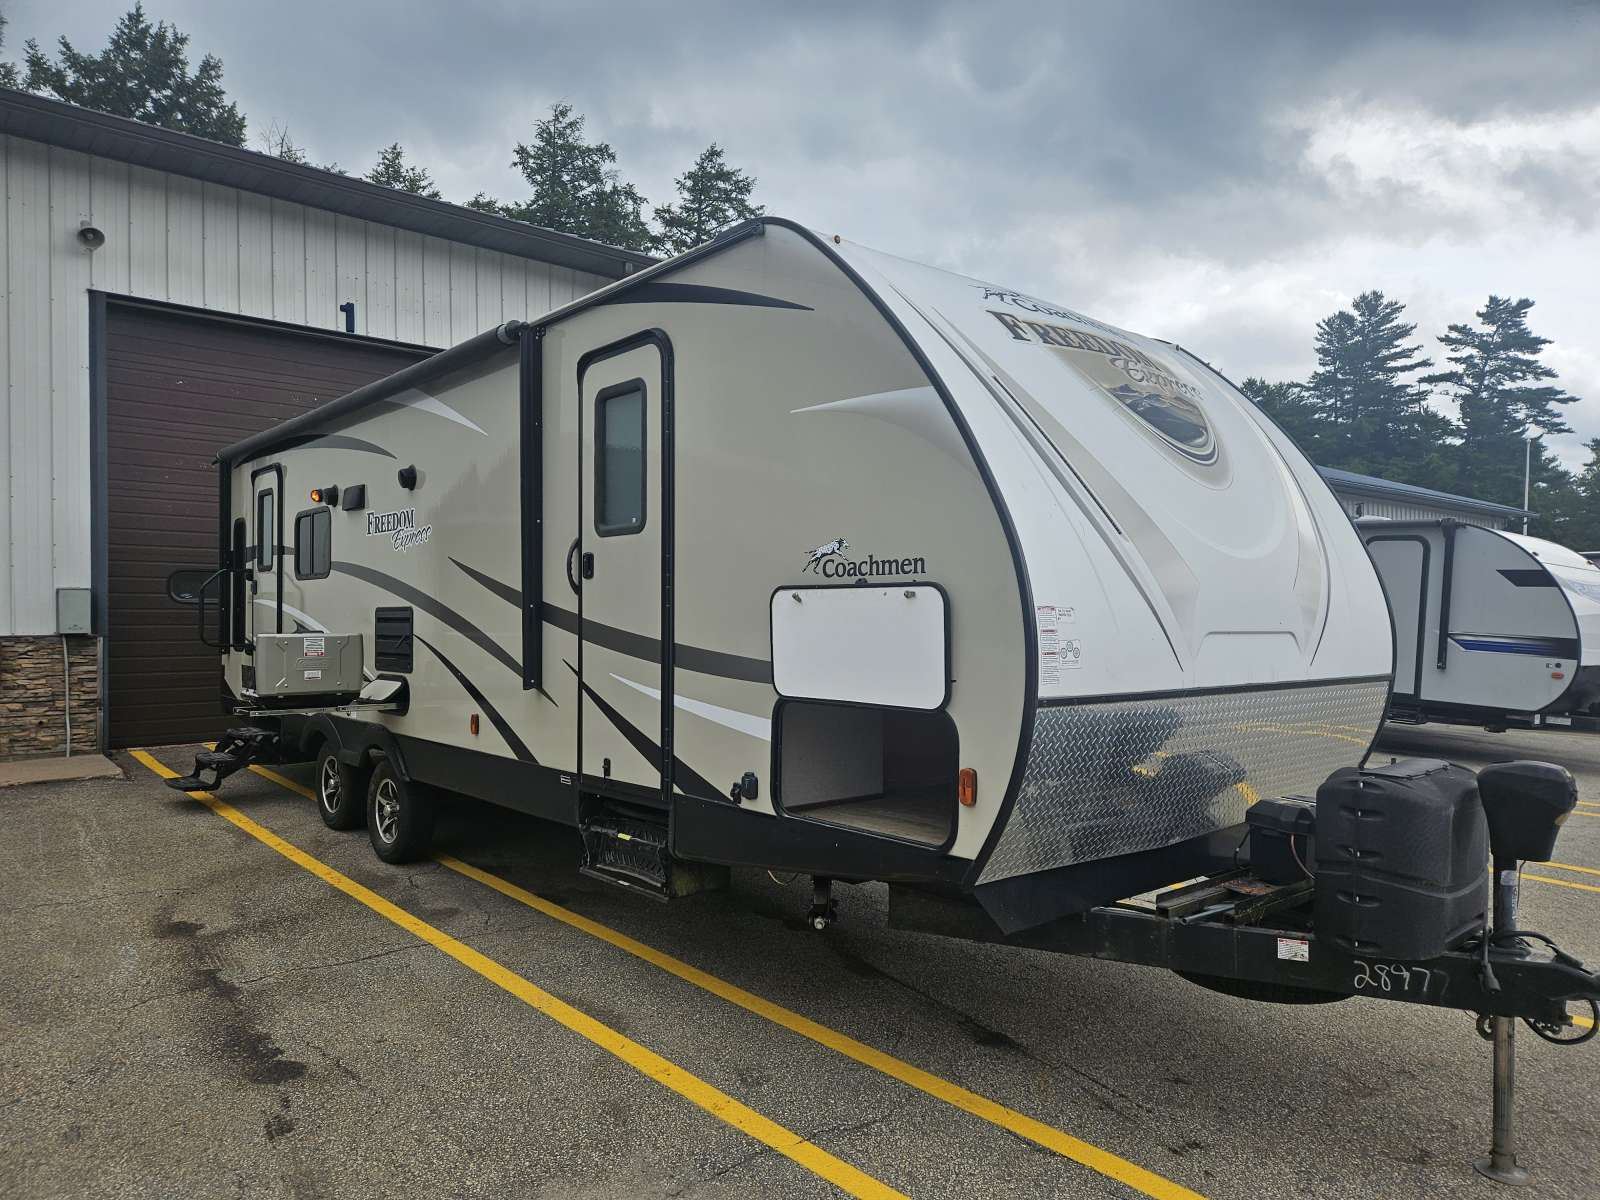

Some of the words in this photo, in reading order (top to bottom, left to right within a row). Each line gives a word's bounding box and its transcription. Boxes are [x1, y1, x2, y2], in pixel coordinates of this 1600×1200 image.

[366, 508, 415, 535] FREEDOM
[391, 525, 432, 552] Express
[822, 554, 926, 578] Coachmen
